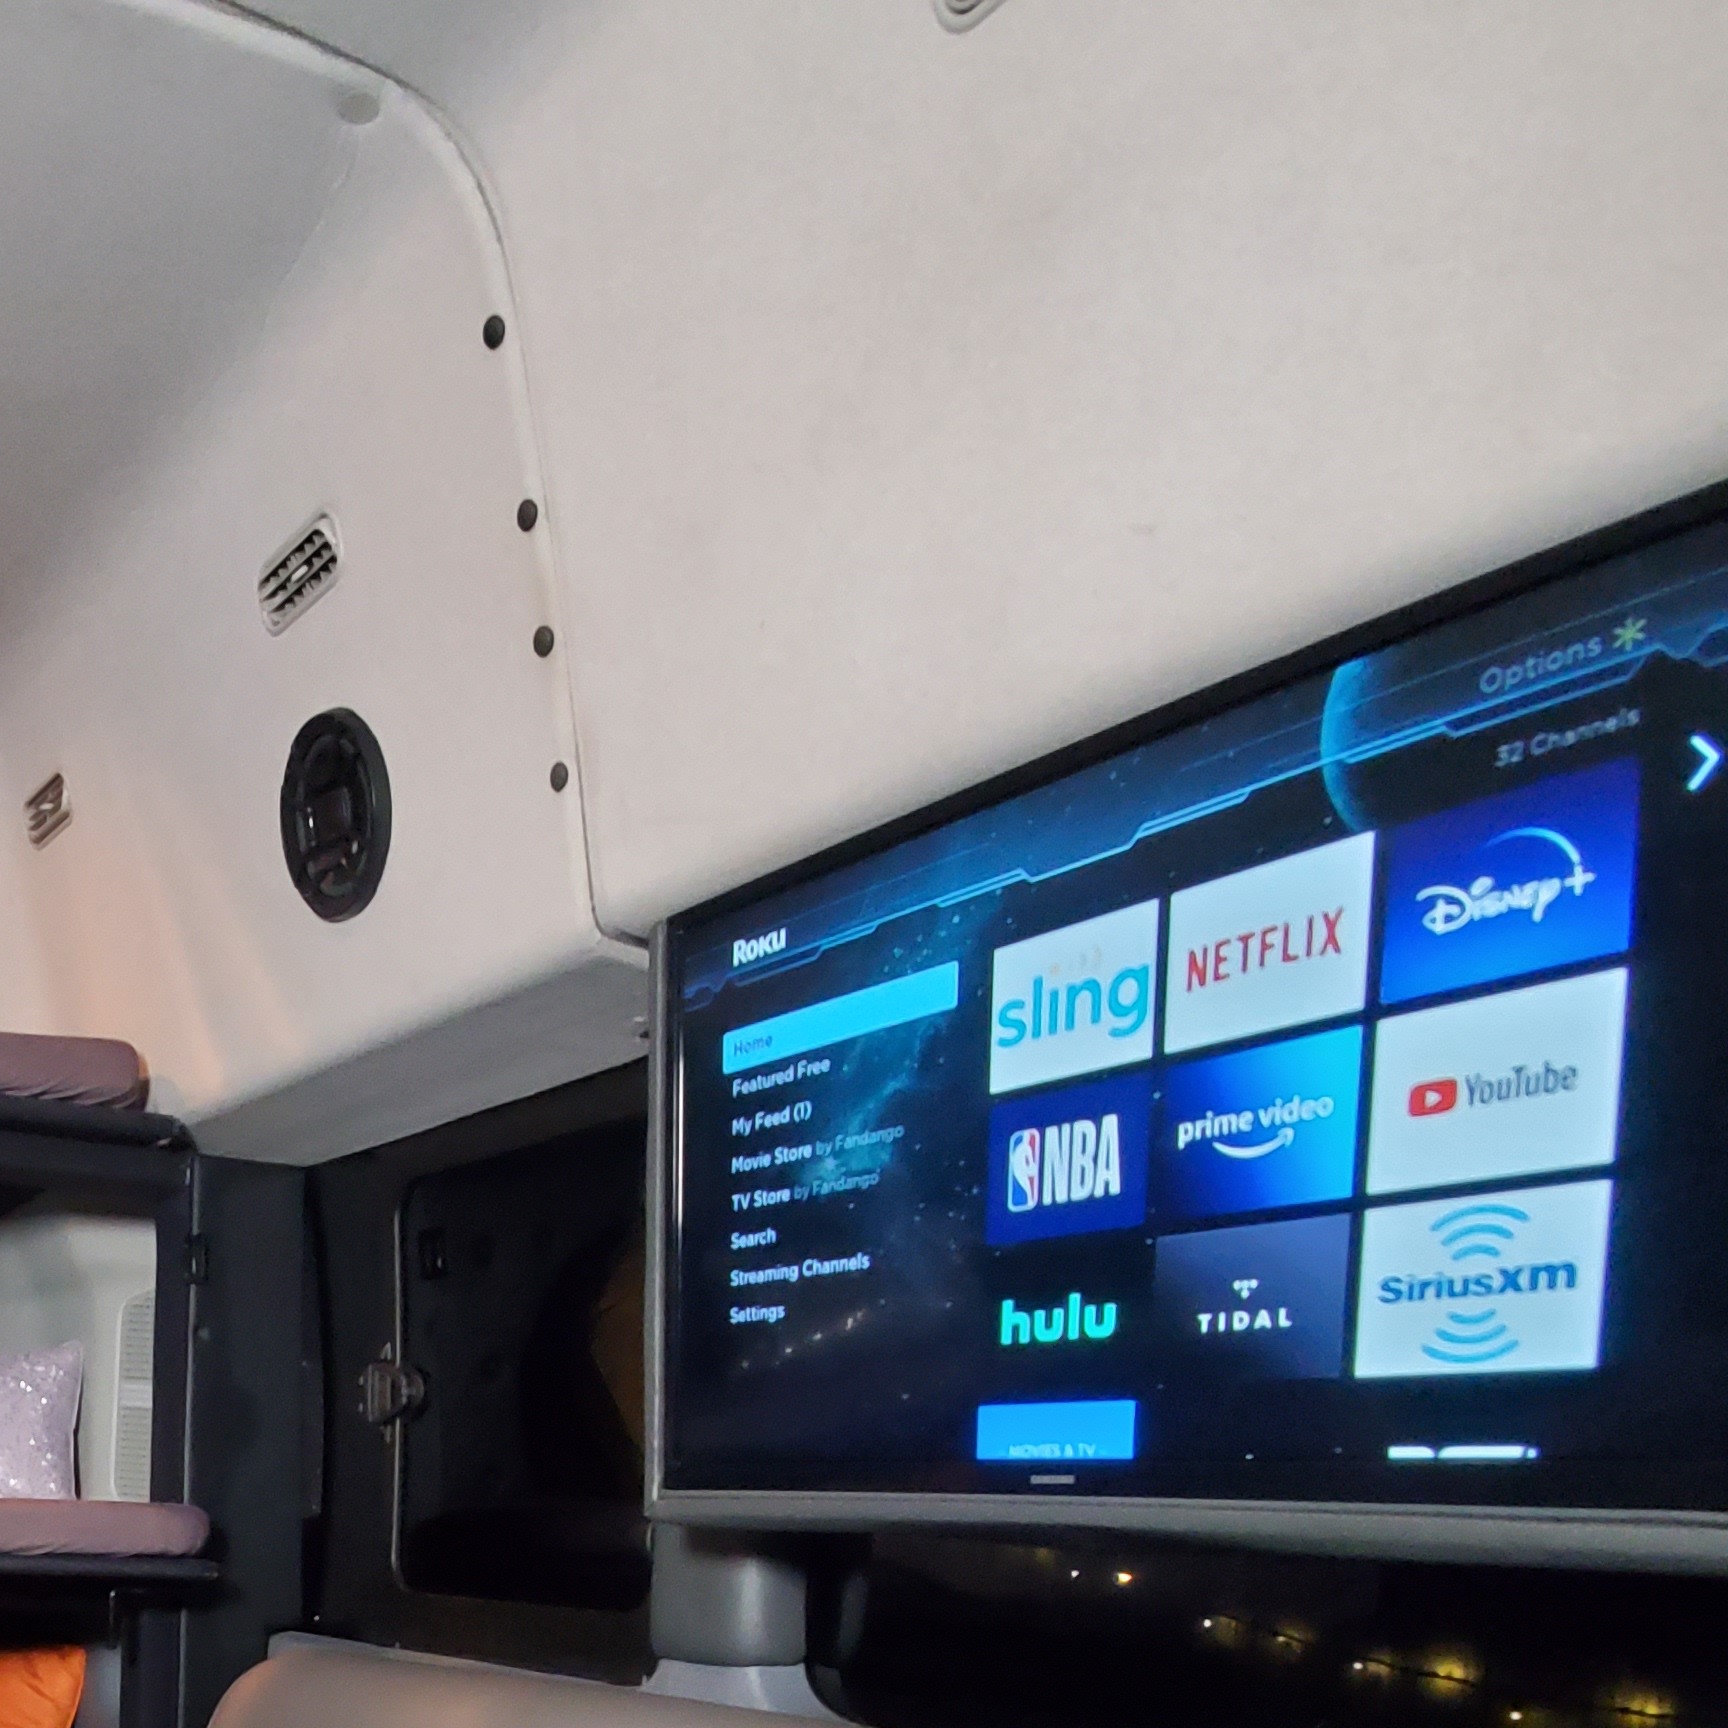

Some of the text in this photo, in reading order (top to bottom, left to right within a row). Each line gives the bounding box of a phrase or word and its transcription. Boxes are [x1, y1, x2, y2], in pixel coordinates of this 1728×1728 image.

[1479, 637, 1603, 694] Options
[1185, 905, 1345, 993] NETFLIX
[998, 963, 1150, 1049] sling
[733, 1034, 774, 1057] Home
[732, 1057, 832, 1098] Featured Free
[1464, 1060, 1580, 1106] YouTube
[731, 1100, 813, 1137] My Feed (1)
[1176, 1095, 1335, 1150] prime video
[731, 1125, 906, 1174] Movie Store by Fandango
[1042, 1113, 1122, 1206] NBA
[731, 1172, 880, 1212] TV Store by Fandango
[730, 1227, 777, 1250] Search
[730, 1252, 871, 1287] Streaming Channels
[729, 1305, 786, 1325] Settings
[1001, 1293, 1117, 1345] hulu
[1197, 1307, 1293, 1335] TIDAL
[1008, 1443, 1062, 1458] MOVIES
[1077, 1442, 1097, 1458] TV
